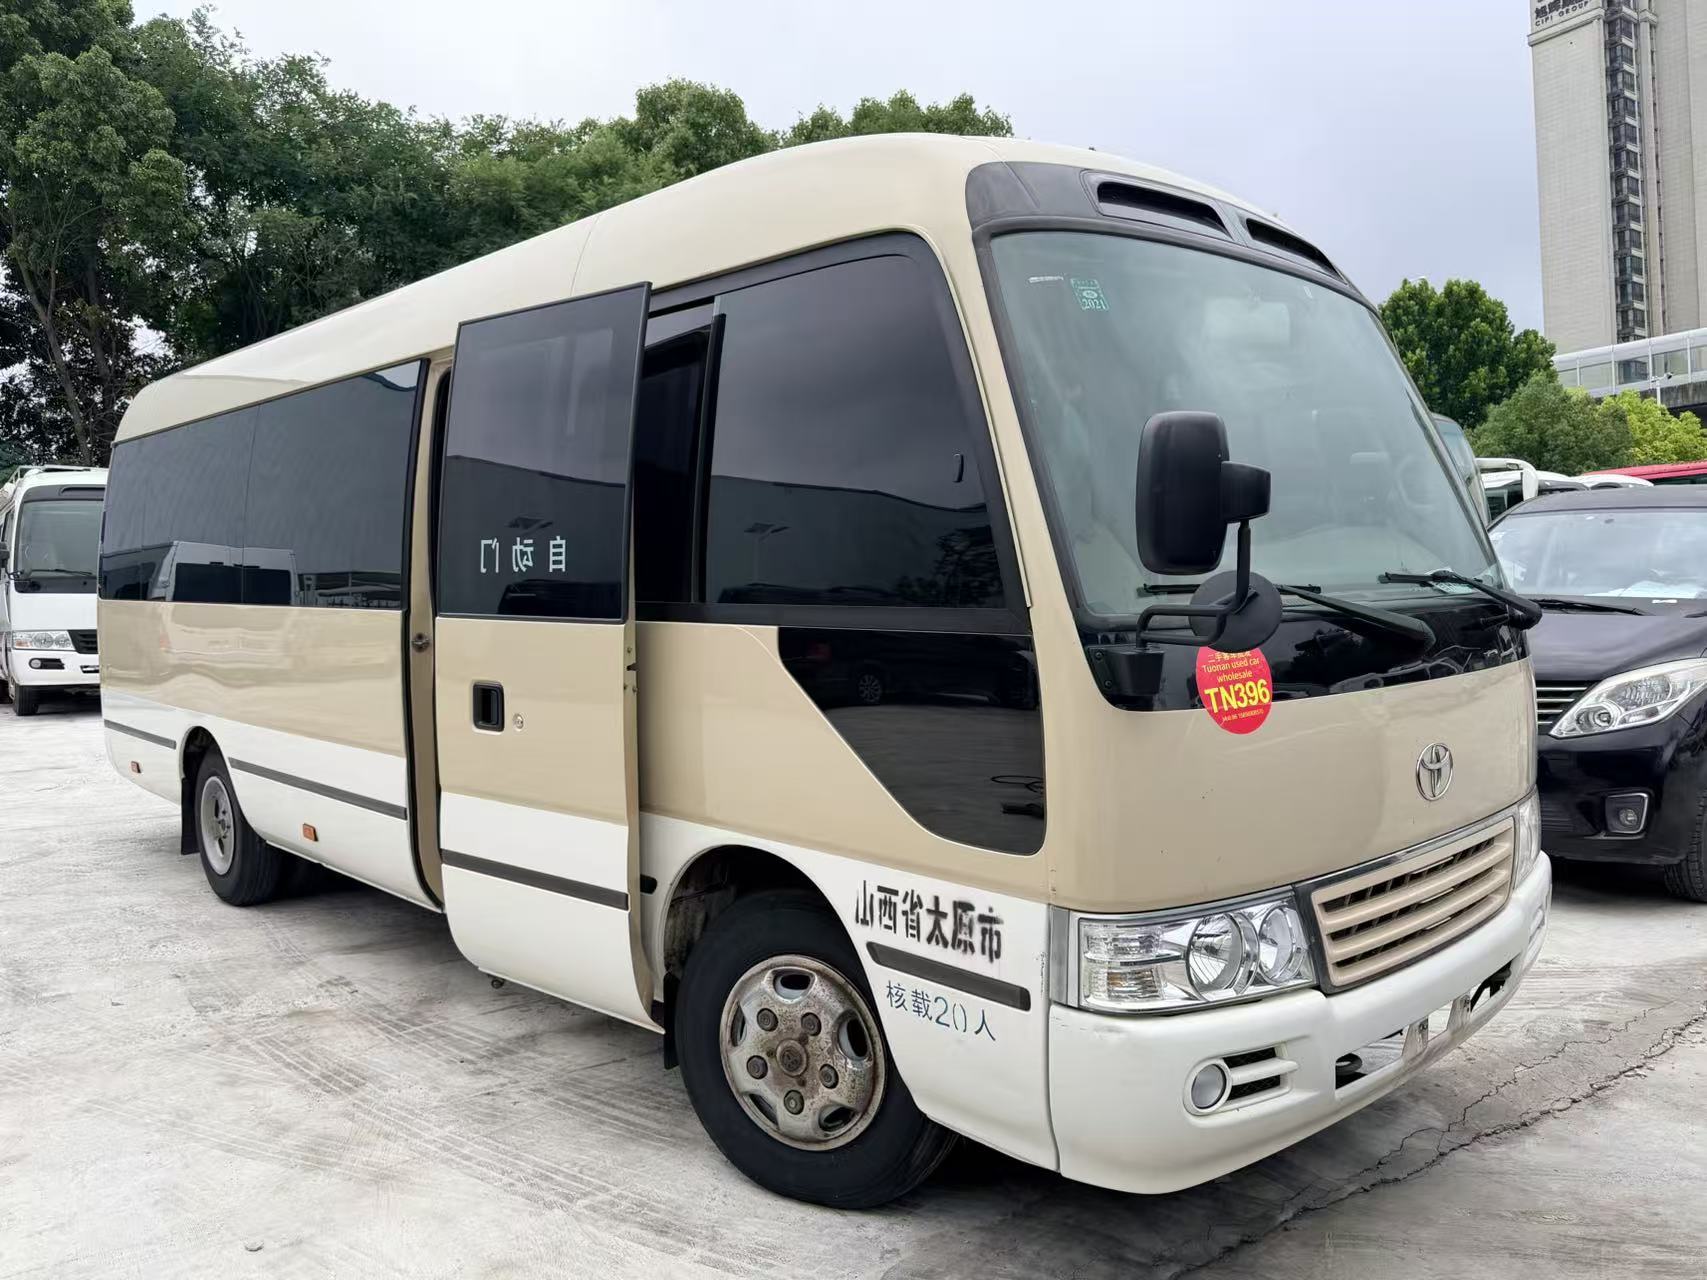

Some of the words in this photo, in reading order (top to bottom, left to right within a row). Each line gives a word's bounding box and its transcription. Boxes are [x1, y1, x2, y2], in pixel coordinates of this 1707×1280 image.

[1558, 1, 1589, 17] GROUP
[1082, 299, 1106, 310] 2021
[1202, 662, 1231, 673] Tuonan
[1231, 658, 1248, 669] used
[1249, 657, 1260, 666] car
[1217, 669, 1253, 683] wholesale
[1204, 679, 1271, 714] TN396
[855, 880, 1004, 964] 山西省太原市
